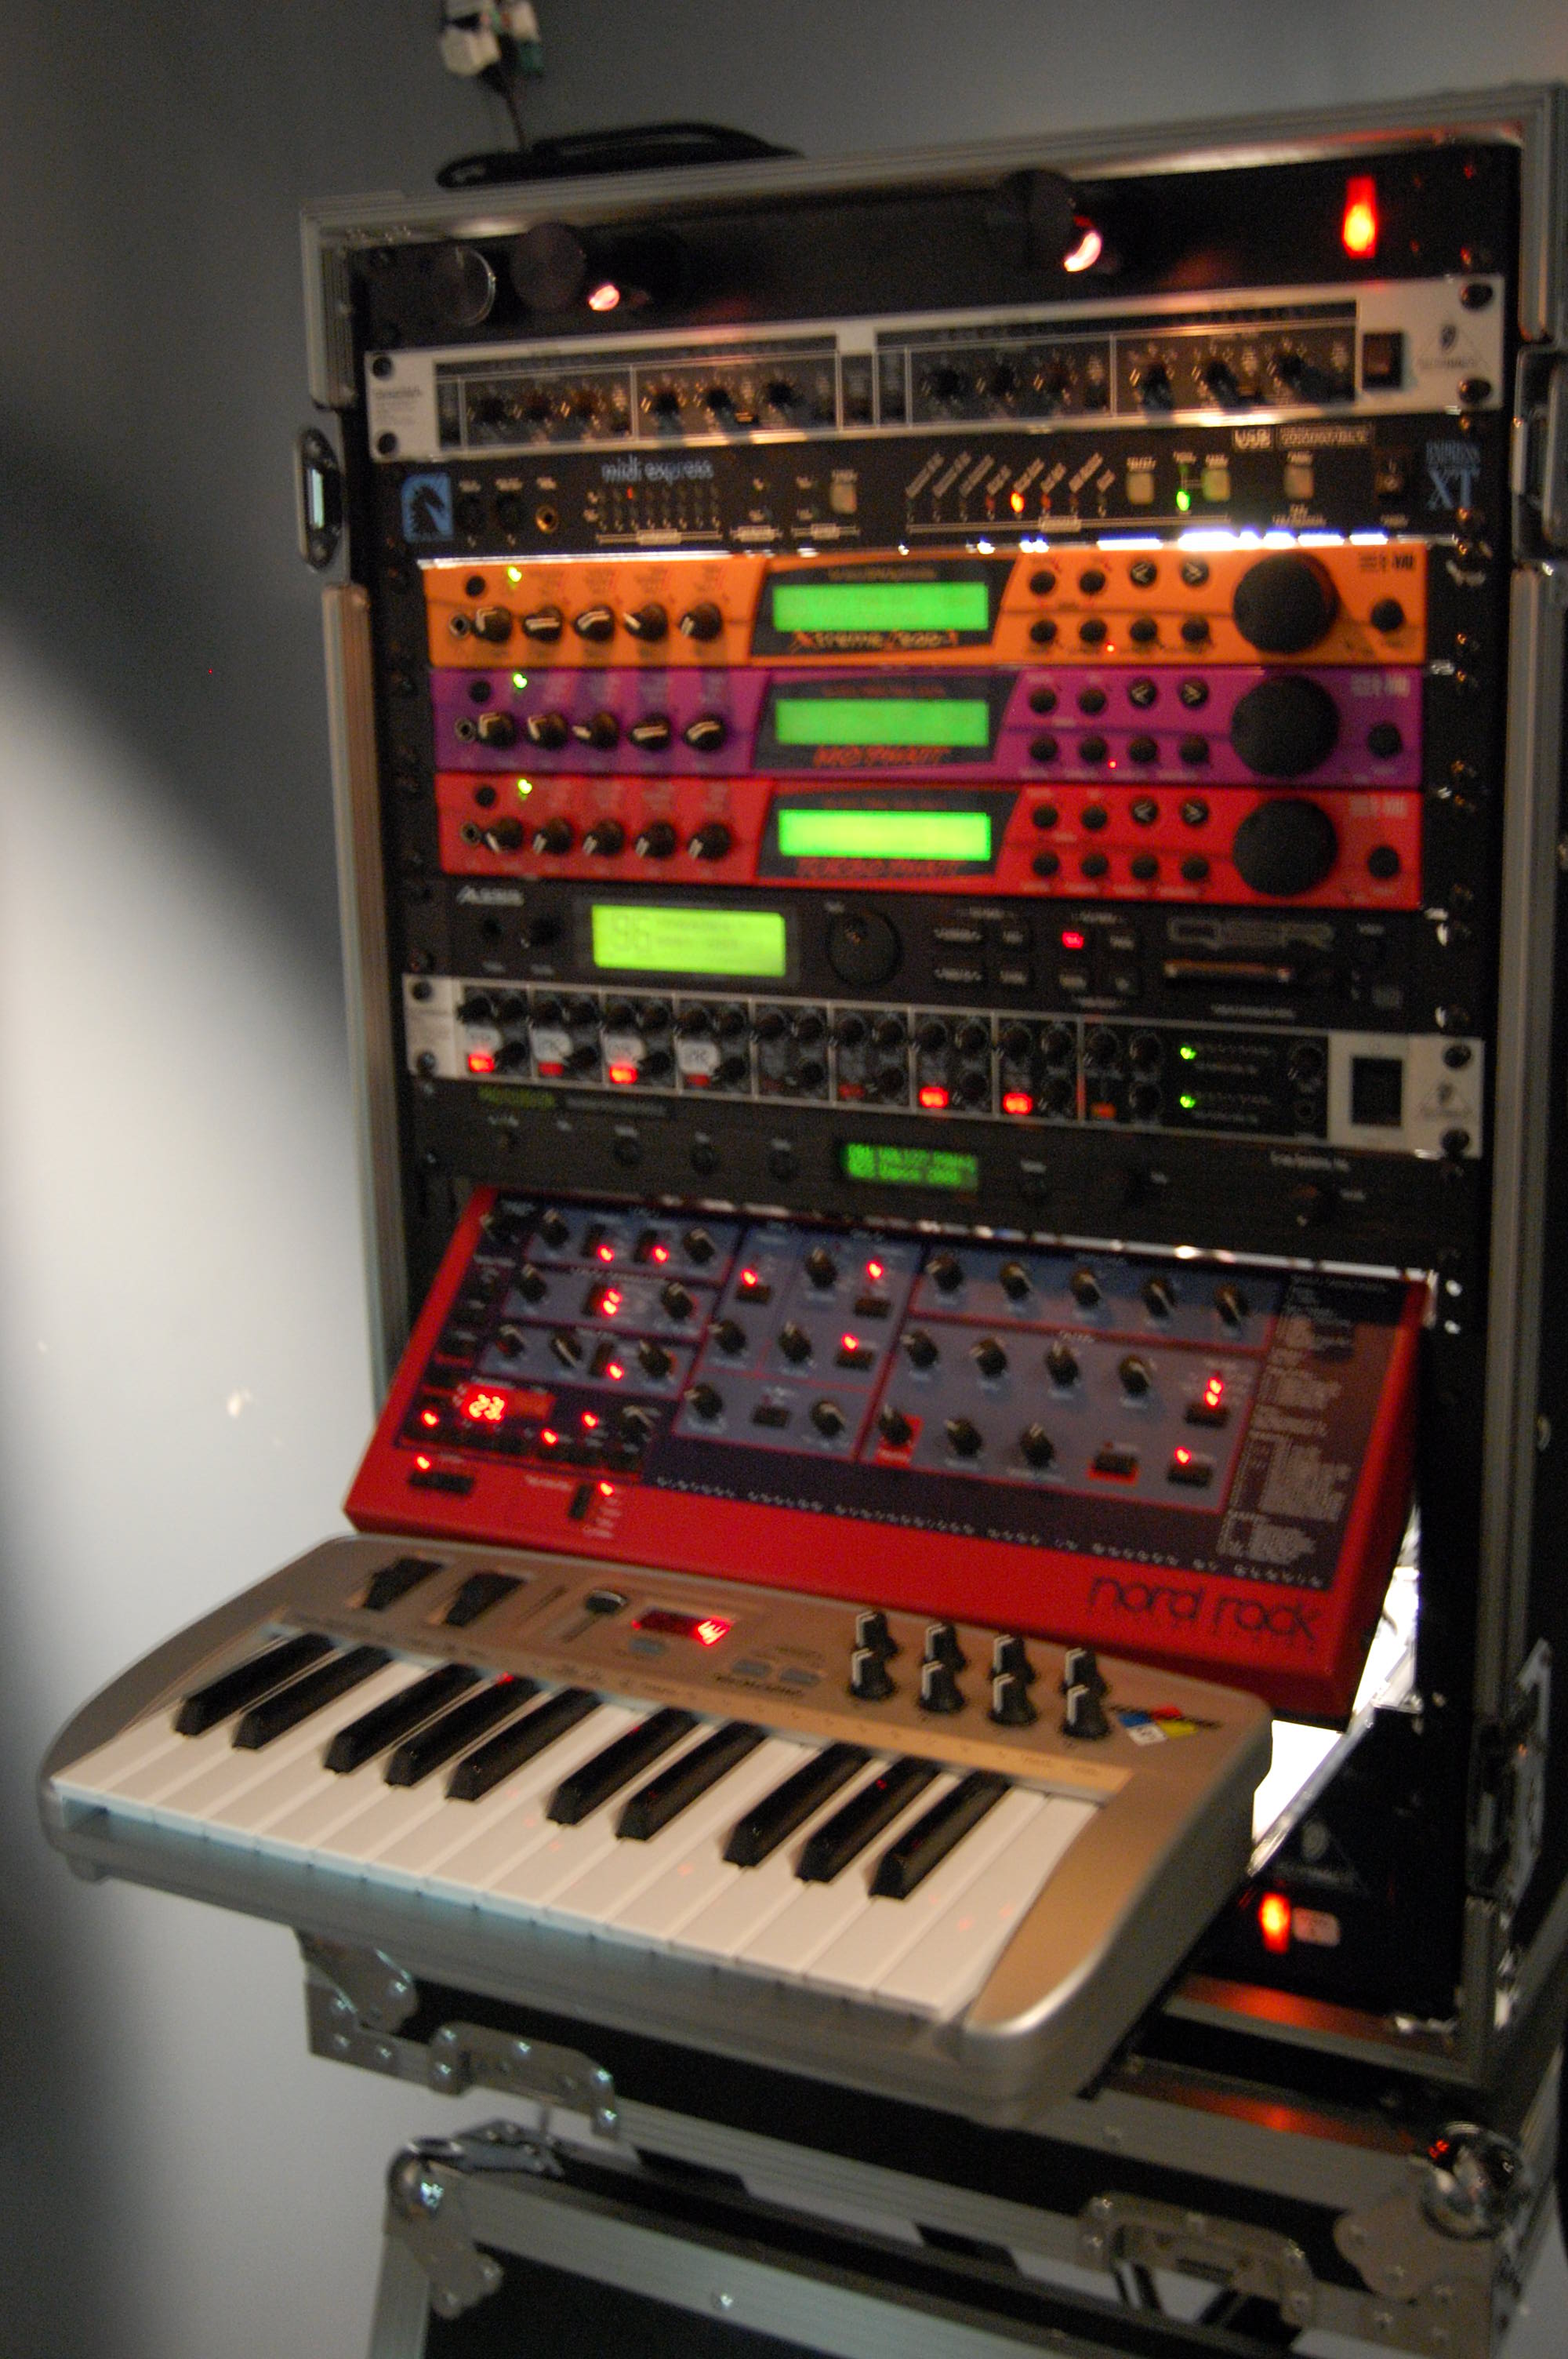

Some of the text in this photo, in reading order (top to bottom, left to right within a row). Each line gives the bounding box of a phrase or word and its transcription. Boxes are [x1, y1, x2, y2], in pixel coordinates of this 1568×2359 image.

[1235, 427, 1272, 449] USB
[644, 459, 715, 485] express
[1087, 1576, 1322, 1644] nord rack
